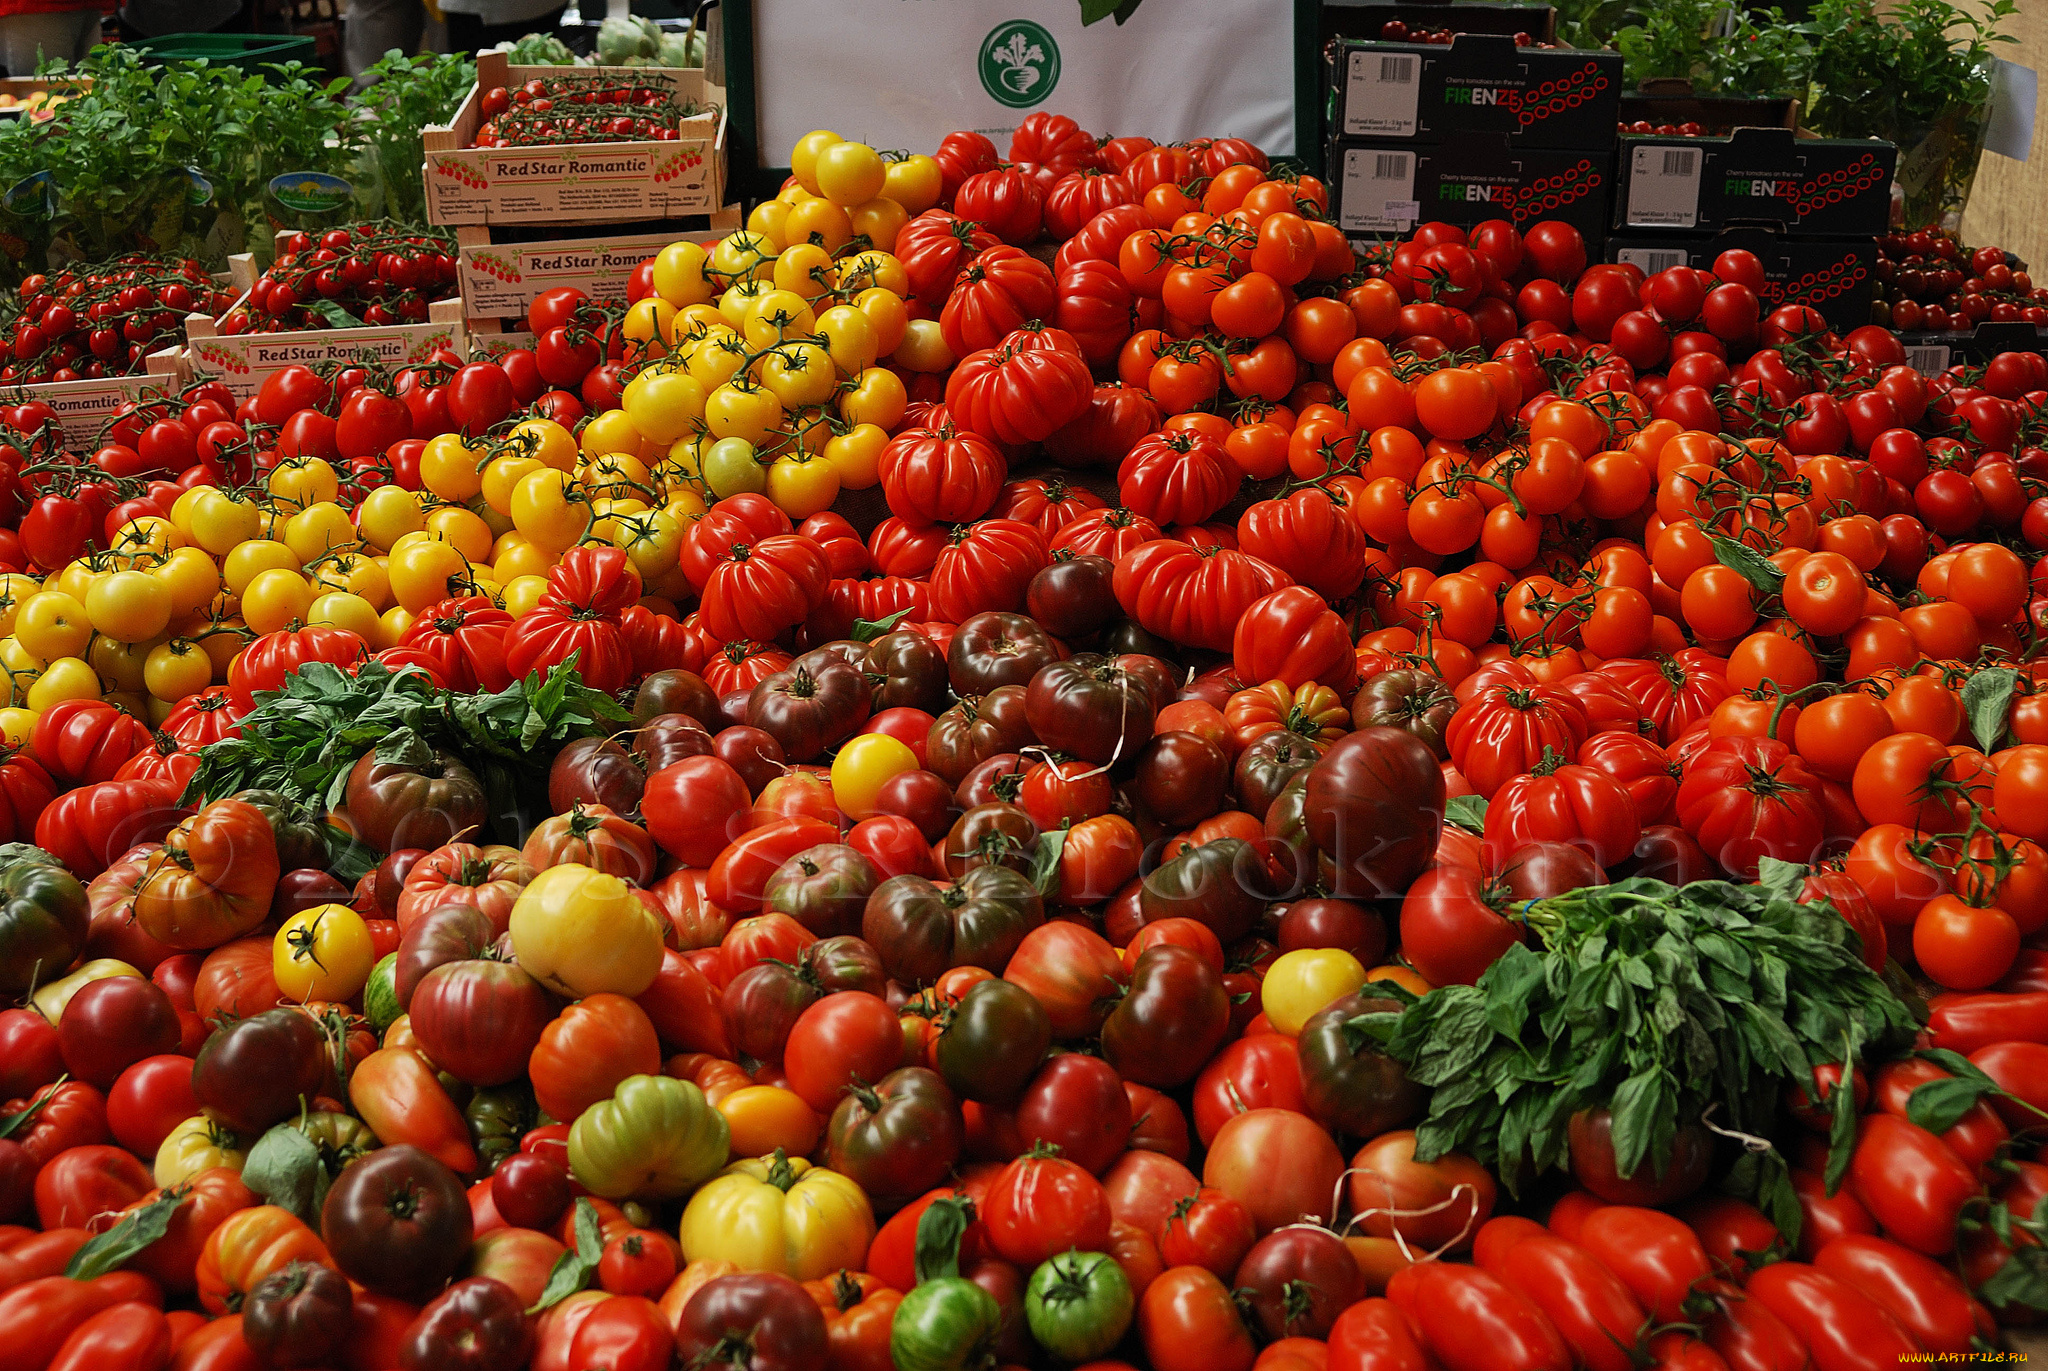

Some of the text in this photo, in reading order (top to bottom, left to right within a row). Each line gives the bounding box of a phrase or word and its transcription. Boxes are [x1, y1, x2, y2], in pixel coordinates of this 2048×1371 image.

[1444, 87, 1519, 106] FIRENZE
[497, 158, 647, 176] Red Star Romantic
[1439, 183, 1513, 202] FIRENZE
[1724, 179, 1797, 197] FIRENZE
[531, 255, 562, 270] Red
[564, 255, 598, 268] Star
[258, 342, 401, 362] Red Star Romntic
[47, 396, 120, 411] Romantic
